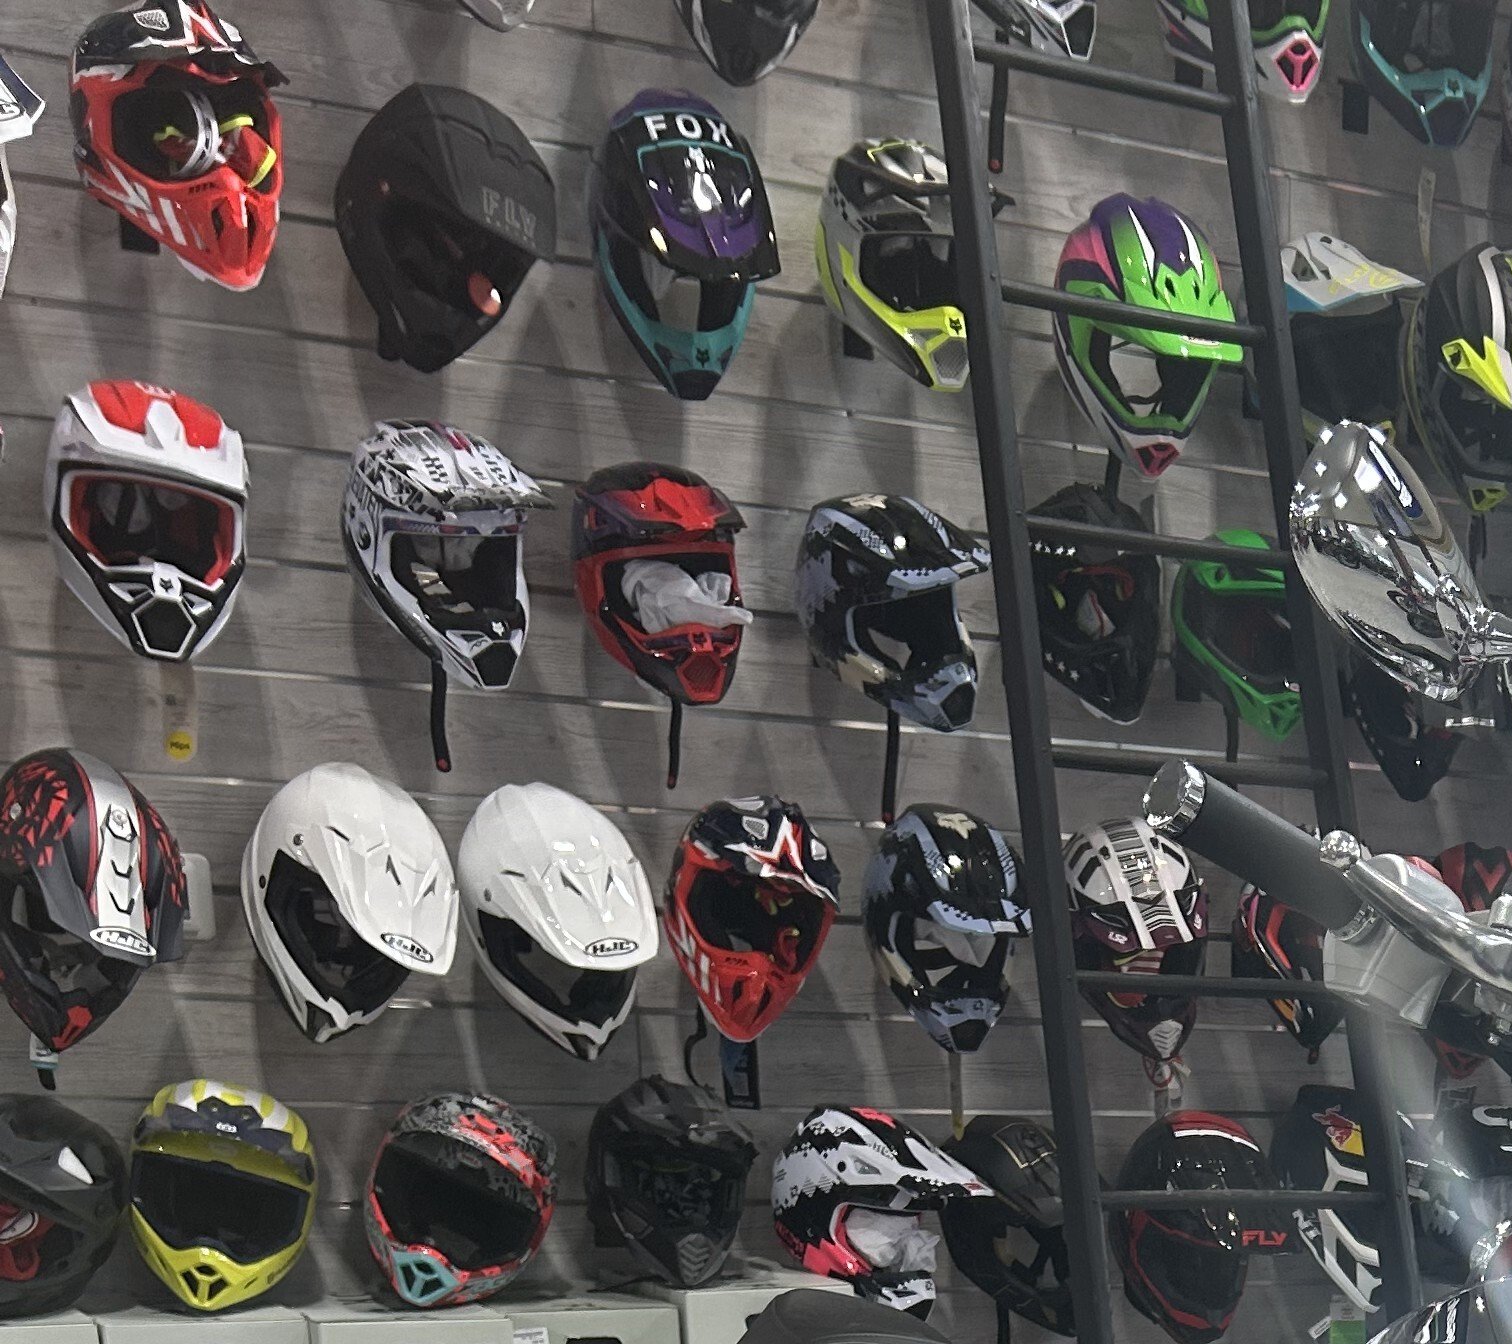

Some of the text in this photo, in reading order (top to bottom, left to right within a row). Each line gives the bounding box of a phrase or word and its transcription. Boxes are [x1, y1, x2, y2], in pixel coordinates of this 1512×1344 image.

[644, 113, 733, 149] FOX
[100, 930, 149, 953] HJC
[388, 935, 430, 961] HJC
[591, 940, 633, 955] HJC
[1241, 1229, 1288, 1247] FLY
